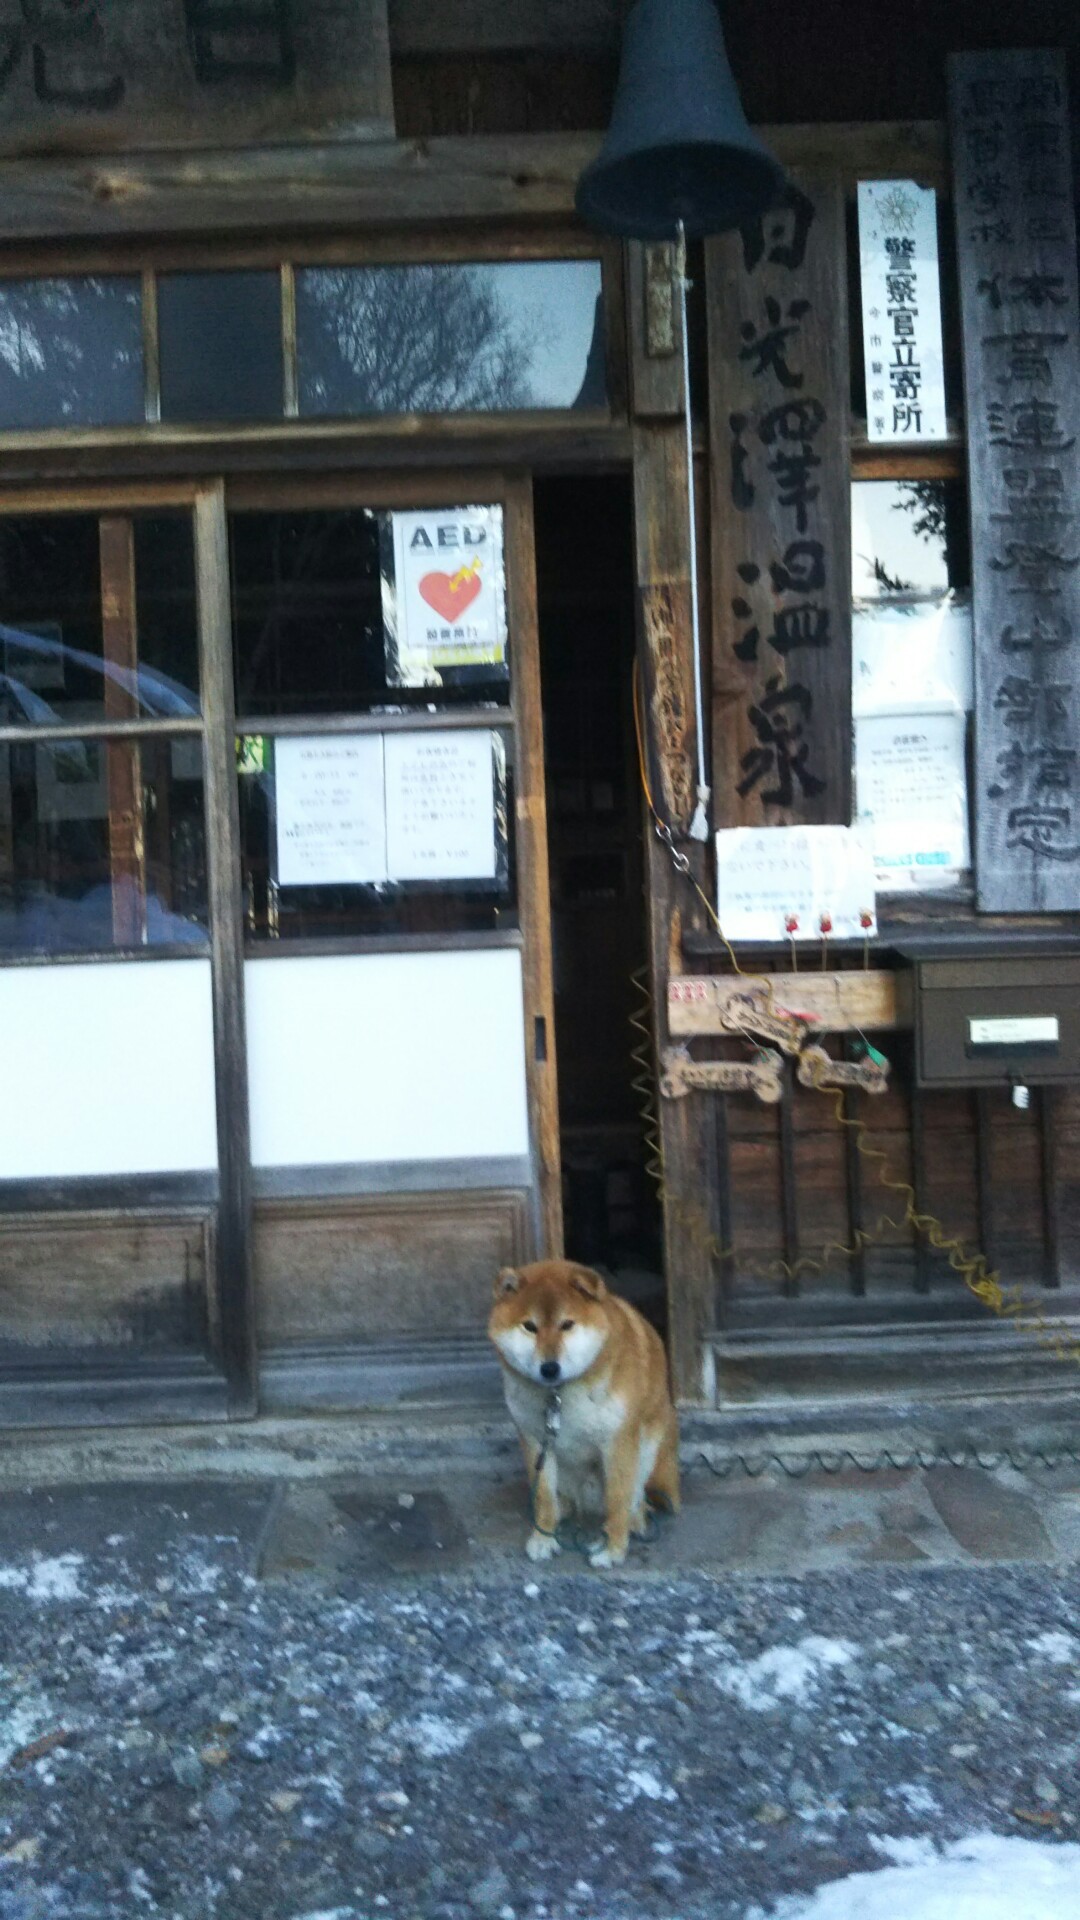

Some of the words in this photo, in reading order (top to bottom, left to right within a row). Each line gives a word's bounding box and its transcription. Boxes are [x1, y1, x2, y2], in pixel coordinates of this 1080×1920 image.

[884, 236, 923, 434] 警察官立寄所
[409, 524, 487, 550] AED
